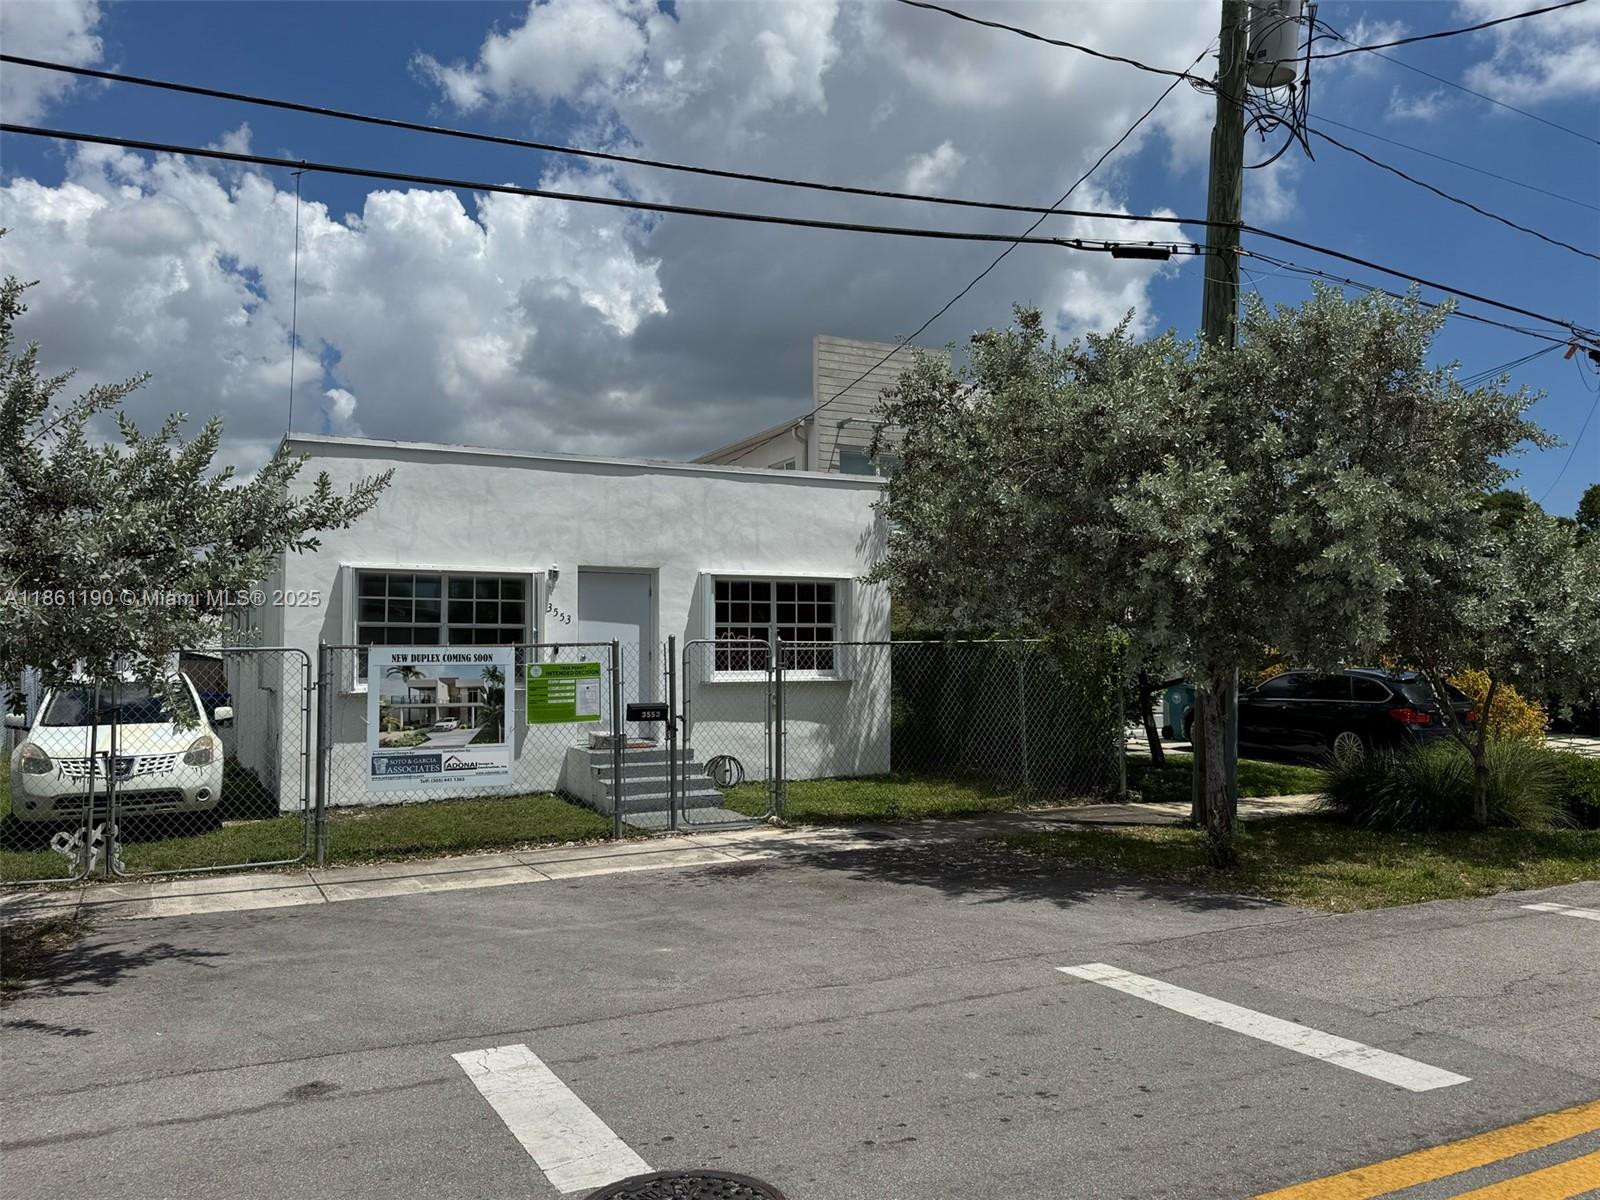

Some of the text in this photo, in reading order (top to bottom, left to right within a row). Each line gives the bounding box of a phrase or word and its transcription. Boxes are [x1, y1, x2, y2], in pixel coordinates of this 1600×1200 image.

[546, 602, 571, 625] 3553
[391, 653, 494, 663] NEW DUPLEX COMING SOON
[386, 764, 441, 774] ASSOCIATES
